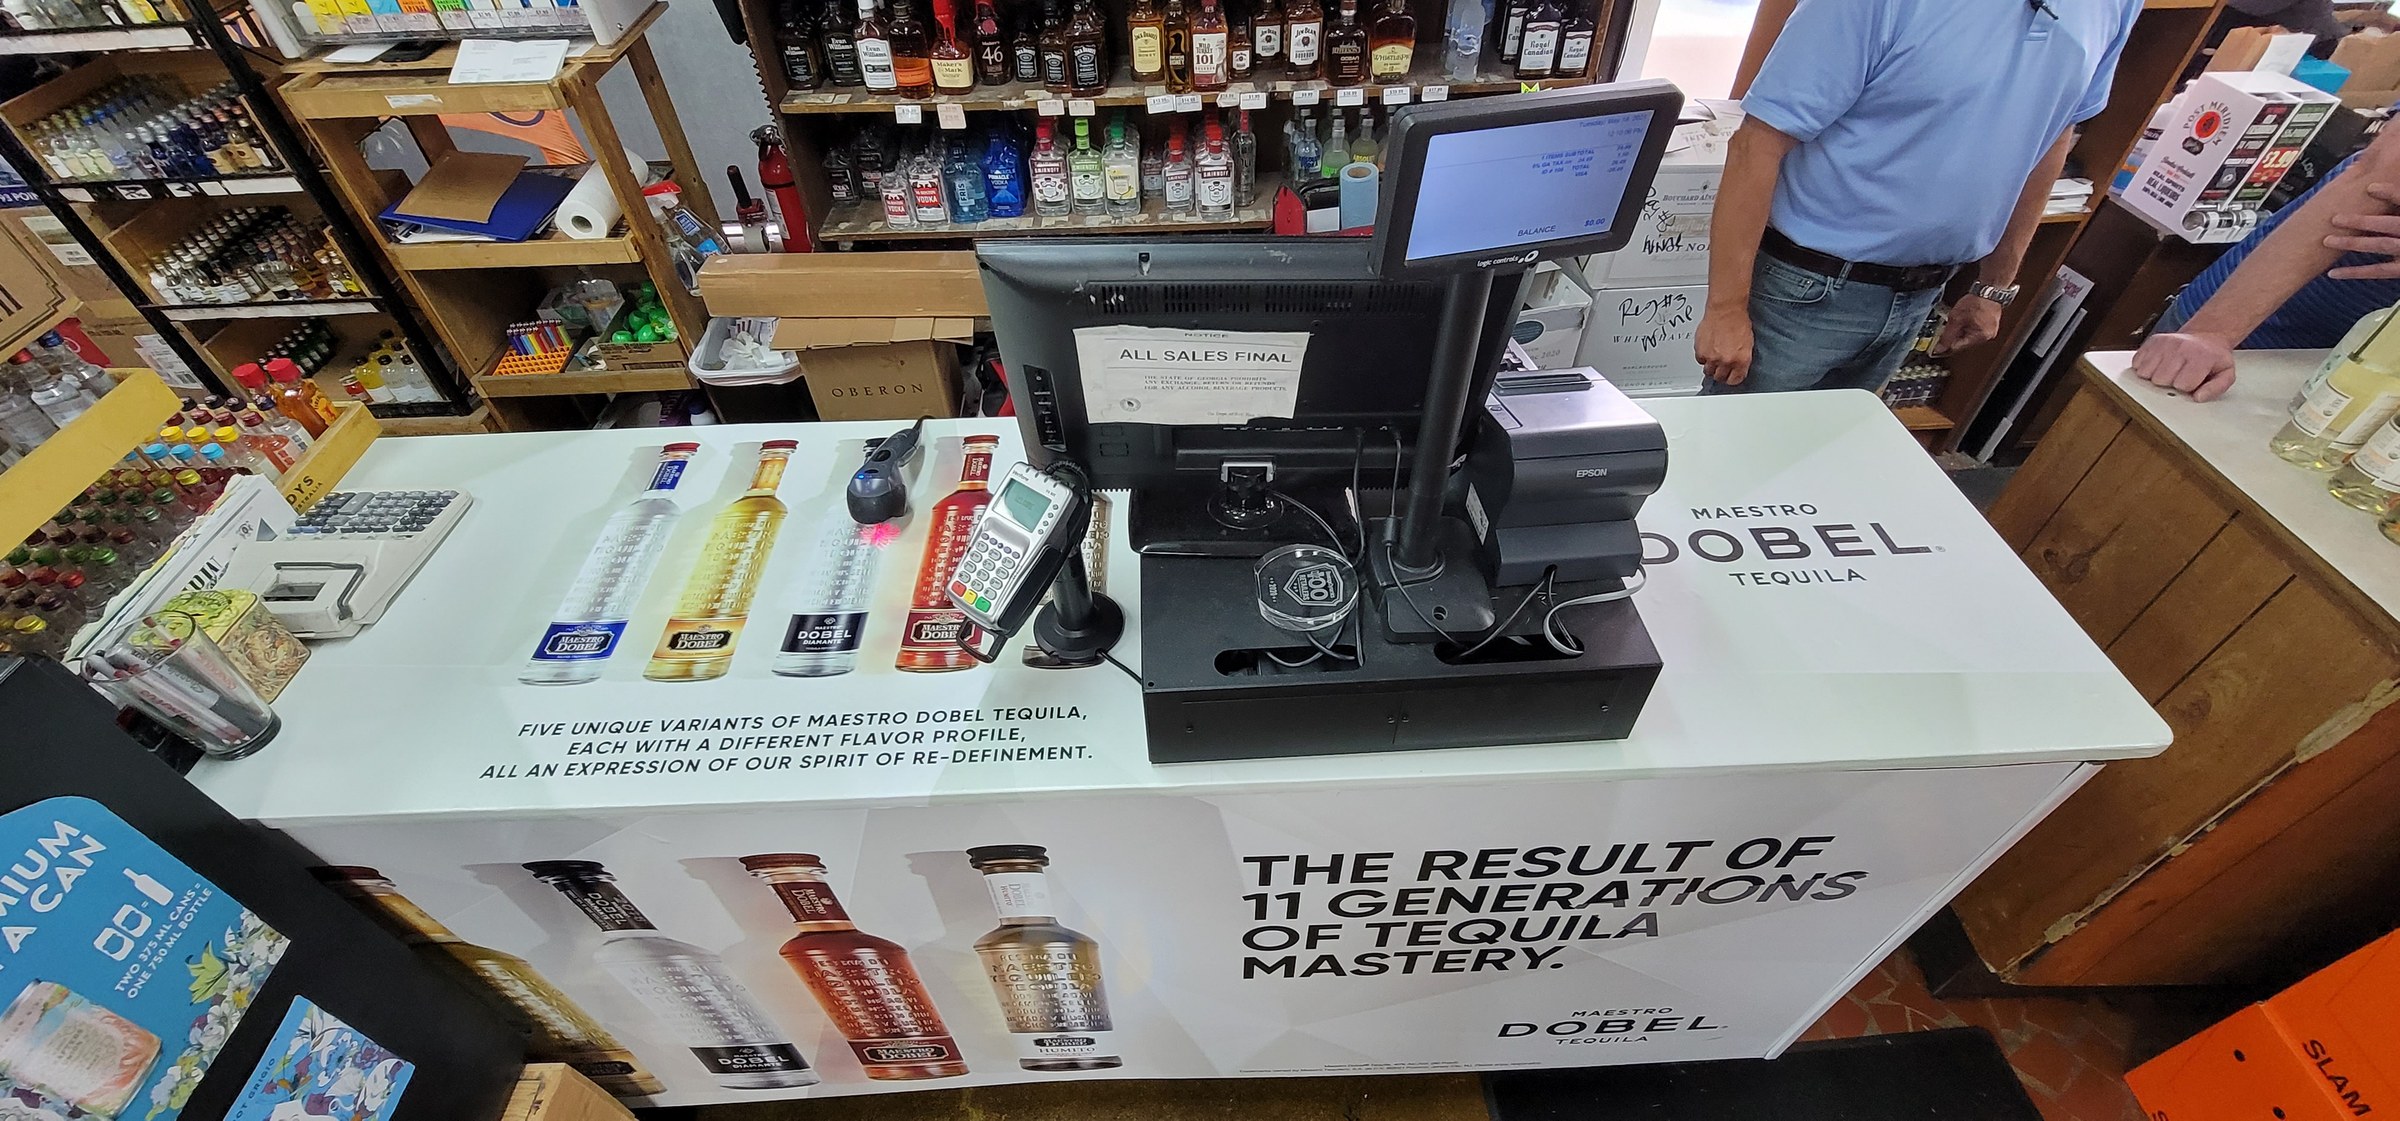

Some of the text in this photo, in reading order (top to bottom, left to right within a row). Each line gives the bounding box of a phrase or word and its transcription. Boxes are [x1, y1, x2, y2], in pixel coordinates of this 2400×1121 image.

[1524, 48, 1553, 56] Canadian
[1530, 40, 1550, 48] Royal
[982, 46, 1004, 65] 46
[1196, 55, 1214, 64] 101
[2183, 104, 2205, 129] POST
[888, 205, 905, 213] VODKA
[917, 196, 938, 204] VODKA
[1517, 218, 1606, 237] BALANCE $0.00
[1477, 255, 1519, 267] logic controls
[1120, 349, 1292, 363] ALL SALES FINAL
[832, 384, 923, 398] OBERON
[1576, 468, 1608, 479] EPSON
[1690, 503, 1818, 520] MAESTRO
[1640, 522, 1933, 565] DOBEL
[1729, 567, 1867, 586] TEQUILA
[558, 634, 604, 645] MAESTRO
[678, 632, 725, 642] MAESTRO
[797, 629, 852, 639] DOBEL
[921, 631, 958, 640] DOBE
[555, 641, 599, 653] DOBEL
[675, 638, 722, 650] DOBEL
[518, 706, 1088, 737] FIVE UNIQUE VARIANTS OF MAESTRO DOBEL TEQUILA,
[567, 727, 1026, 756] EACH WITH A DIFFERENT FLAVOR PROFILE,
[479, 745, 1093, 779] ALL AN EXPRESSION OF OUR SPIRIT OF RE-DEFINEMENT.
[1243, 836, 1836, 886] THE RESULT OF
[30, 833, 107, 913] CAN
[1242, 871, 1870, 920] 11 GENERATIONS
[587, 892, 628, 925] DOBEL
[115, 889, 196, 992] TWO 375 ML CANS
[1242, 912, 1658, 951] OF TEQUILA
[127, 887, 213, 999] ONE 750 ML BOTTLE
[1243, 945, 1567, 979] MASTERY.
[1571, 1007, 1673, 1017] MAESTRO
[1497, 1016, 1719, 1038] DOBEL
[1556, 1035, 1648, 1045] TEQUILA
[718, 1056, 789, 1065] DOBEL
[248, 1057, 276, 1100] GRIGIO
[2302, 1039, 2372, 1117] SLAM
